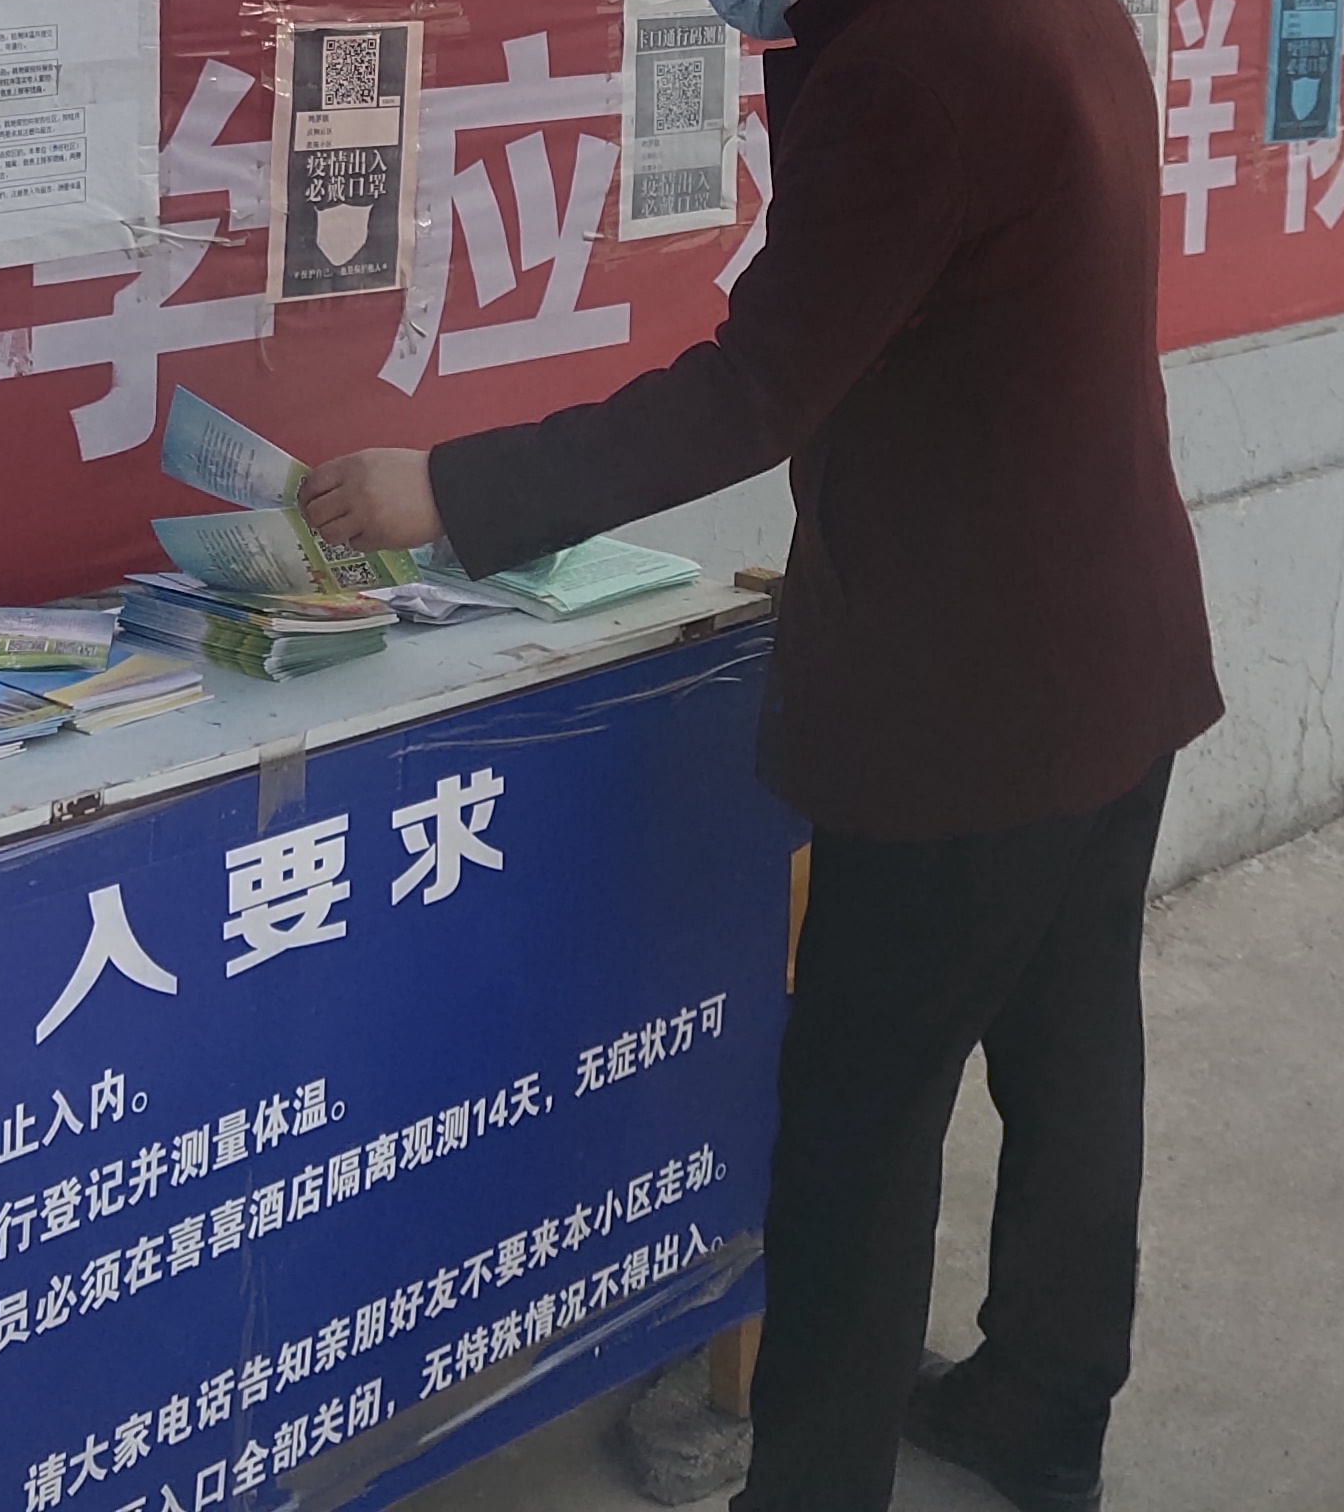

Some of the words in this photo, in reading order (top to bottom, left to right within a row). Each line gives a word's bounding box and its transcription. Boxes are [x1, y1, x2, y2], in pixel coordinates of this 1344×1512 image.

[307, 149, 387, 179] 疫情出入
[306, 174, 387, 203] 必戴口罩
[642, 171, 710, 198] 疫情出入
[642, 194, 709, 217] 必戴口罩
